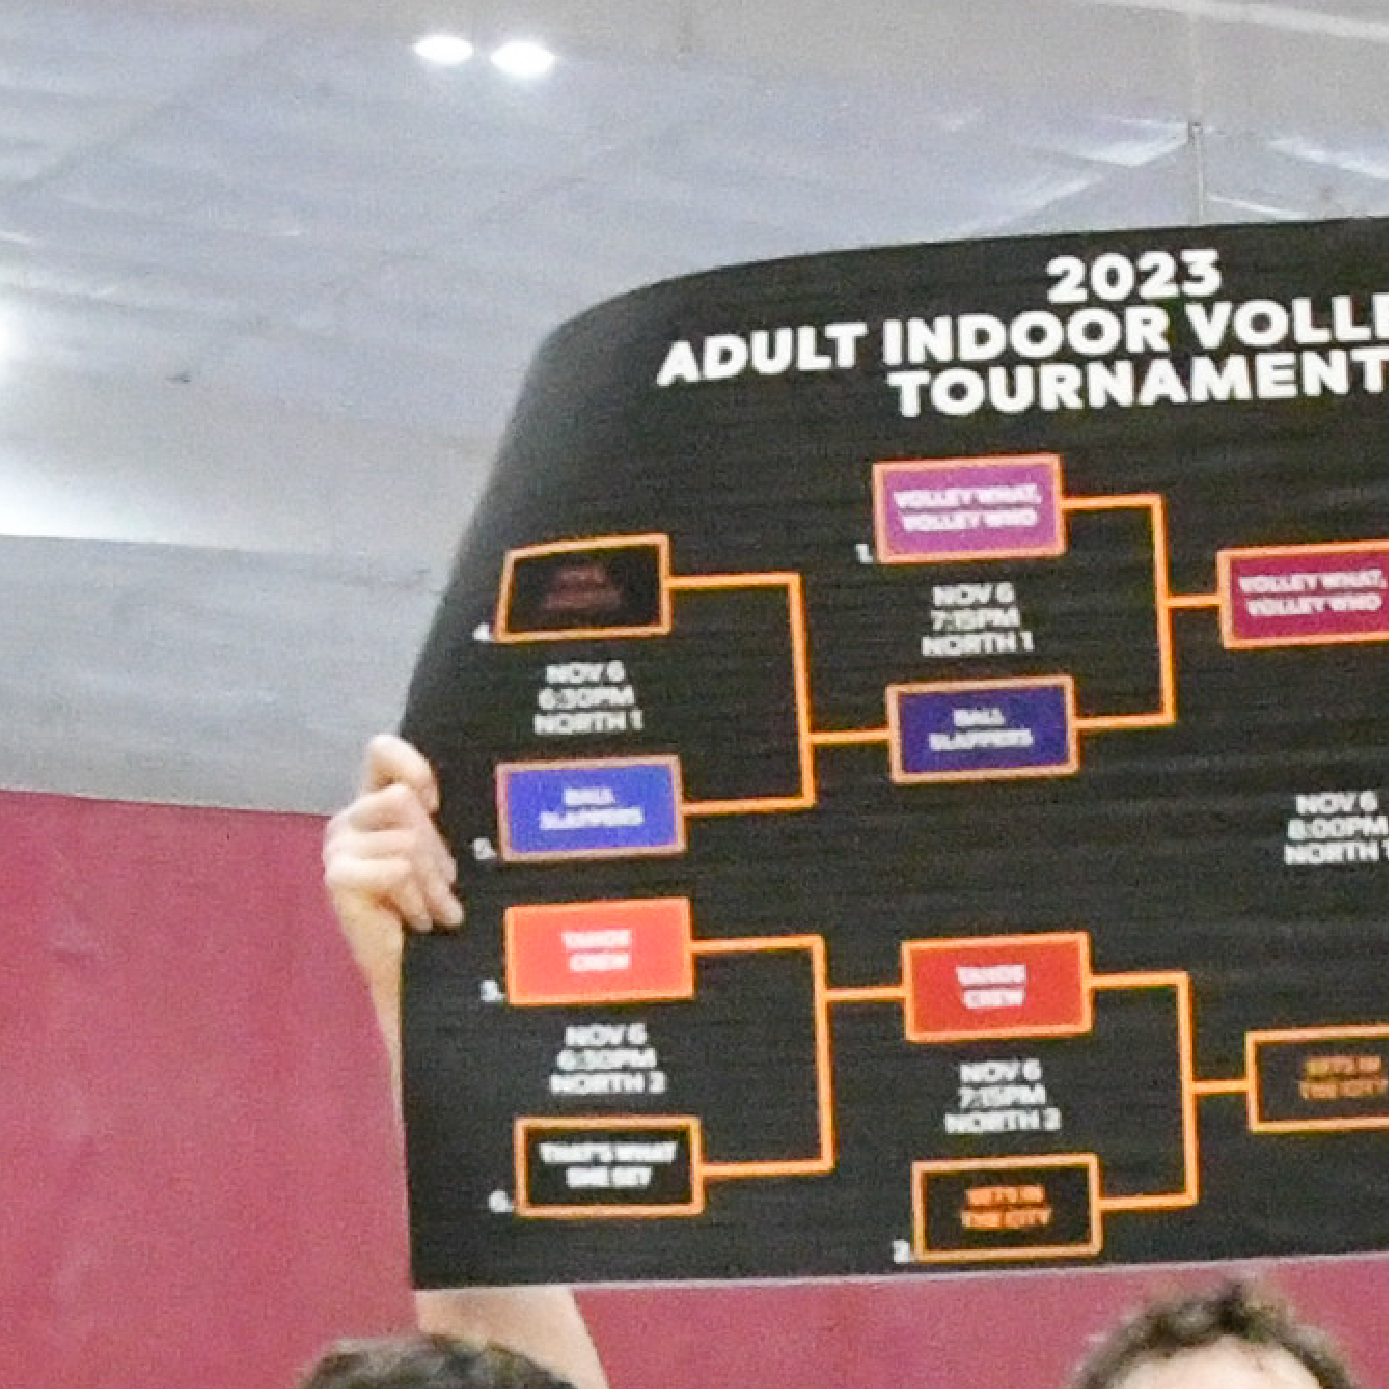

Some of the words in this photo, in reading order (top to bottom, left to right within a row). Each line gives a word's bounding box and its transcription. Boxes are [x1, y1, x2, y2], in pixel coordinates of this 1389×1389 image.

[1046, 250, 1222, 304] 2023
[656, 322, 869, 386] ADULT
[883, 306, 1172, 364] INDOOR
[932, 584, 992, 606] NOV
[921, 633, 1017, 657] NORTH
[1019, 630, 1035, 652] 1
[545, 663, 603, 685] NOV
[533, 711, 627, 735] NORTH
[629, 708, 644, 731] 1
[1295, 792, 1356, 817] NOV
[1283, 840, 1380, 866] NORTH
[564, 1024, 626, 1046] NOV
[548, 1072, 647, 1095] NORTH
[959, 1060, 1021, 1084] NOV
[943, 1110, 1041, 1133] NORTH
